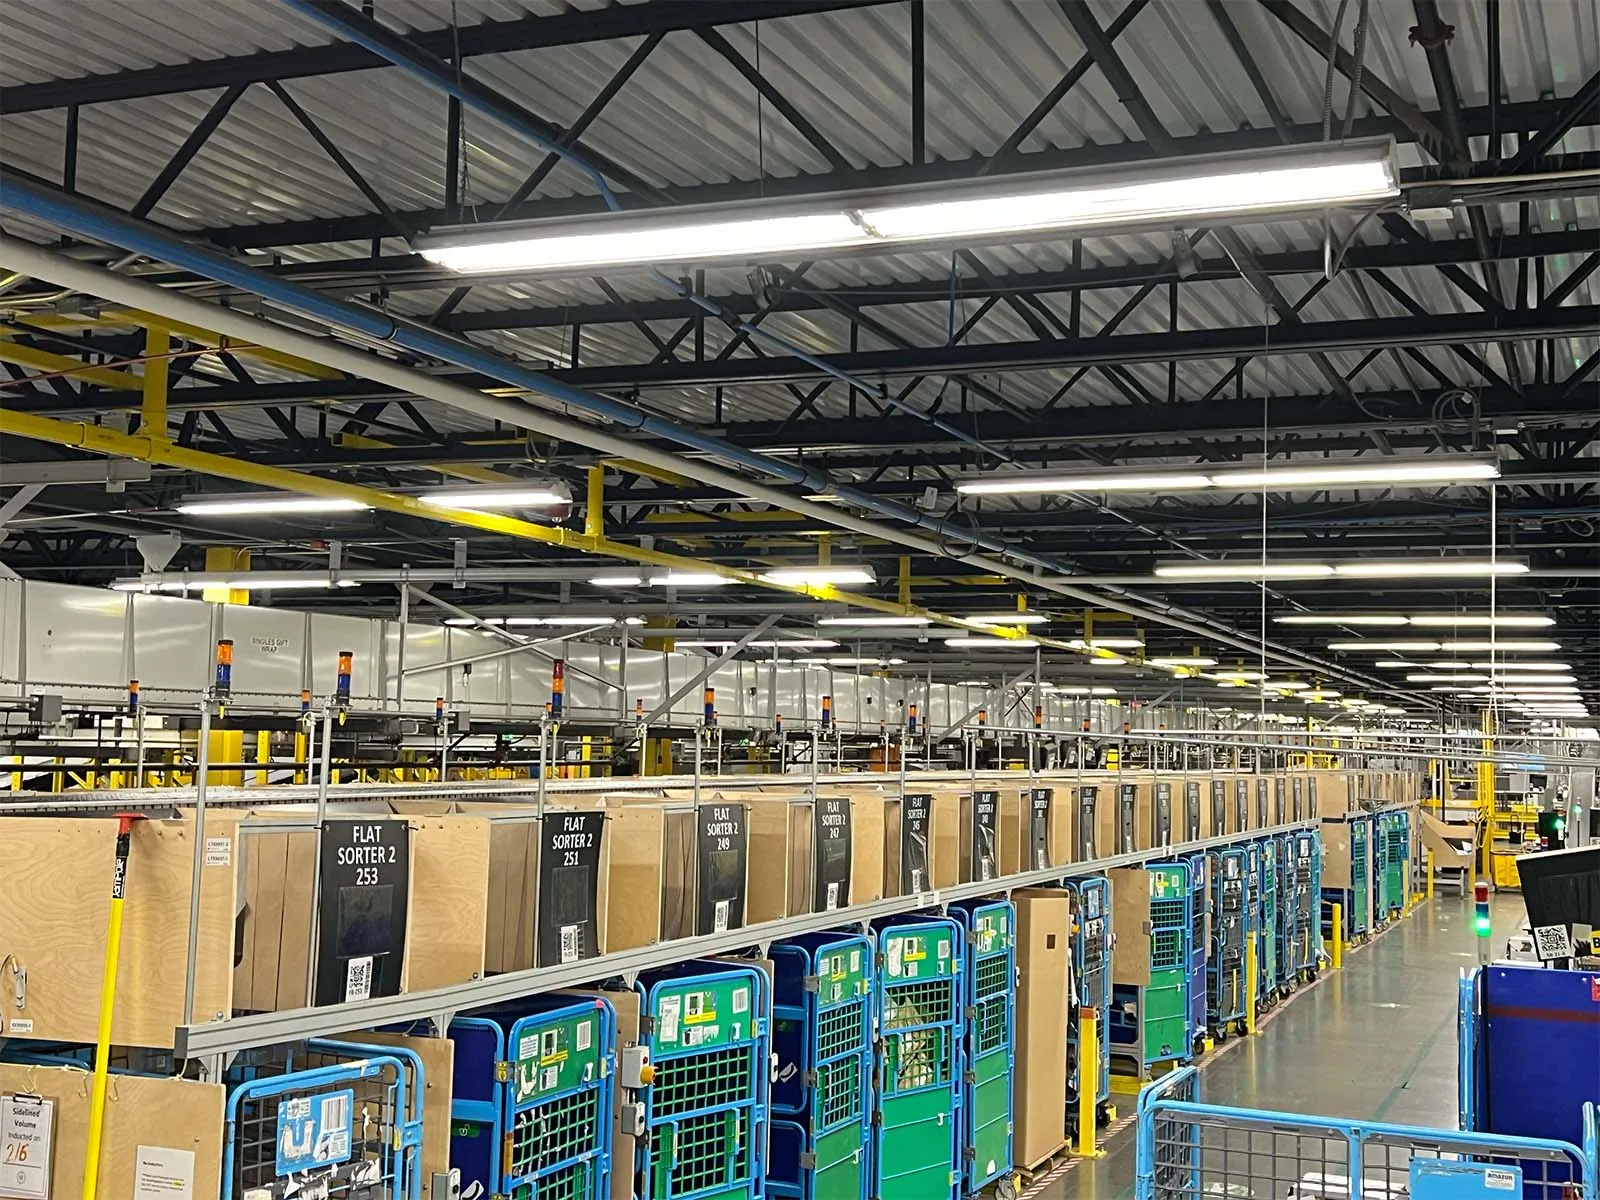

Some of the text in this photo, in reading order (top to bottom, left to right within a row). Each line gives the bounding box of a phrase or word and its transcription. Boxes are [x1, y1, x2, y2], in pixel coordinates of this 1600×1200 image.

[827, 801, 840, 812] FLAT
[912, 797, 923, 807] FLAT
[714, 807, 730, 820] FLAT
[907, 809, 923, 819] SORTER
[563, 816, 586, 831] FLAT
[822, 814, 846, 826] SORTER 2
[353, 825, 382, 843] FLAT
[707, 822, 739, 836] SORTER 2
[829, 827, 839, 839] 247
[552, 833, 593, 850] SORTER 2
[717, 837, 730, 851] 249
[337, 845, 396, 865] SORTER 2
[563, 851, 579, 866] 251
[356, 867, 378, 885] 253
[12, 1107, 40, 1118] Sidelined
[14, 1120, 36, 1129] Volume
[8, 1132, 33, 1142] Inducted
[1487, 1173, 1513, 1181] amazon
